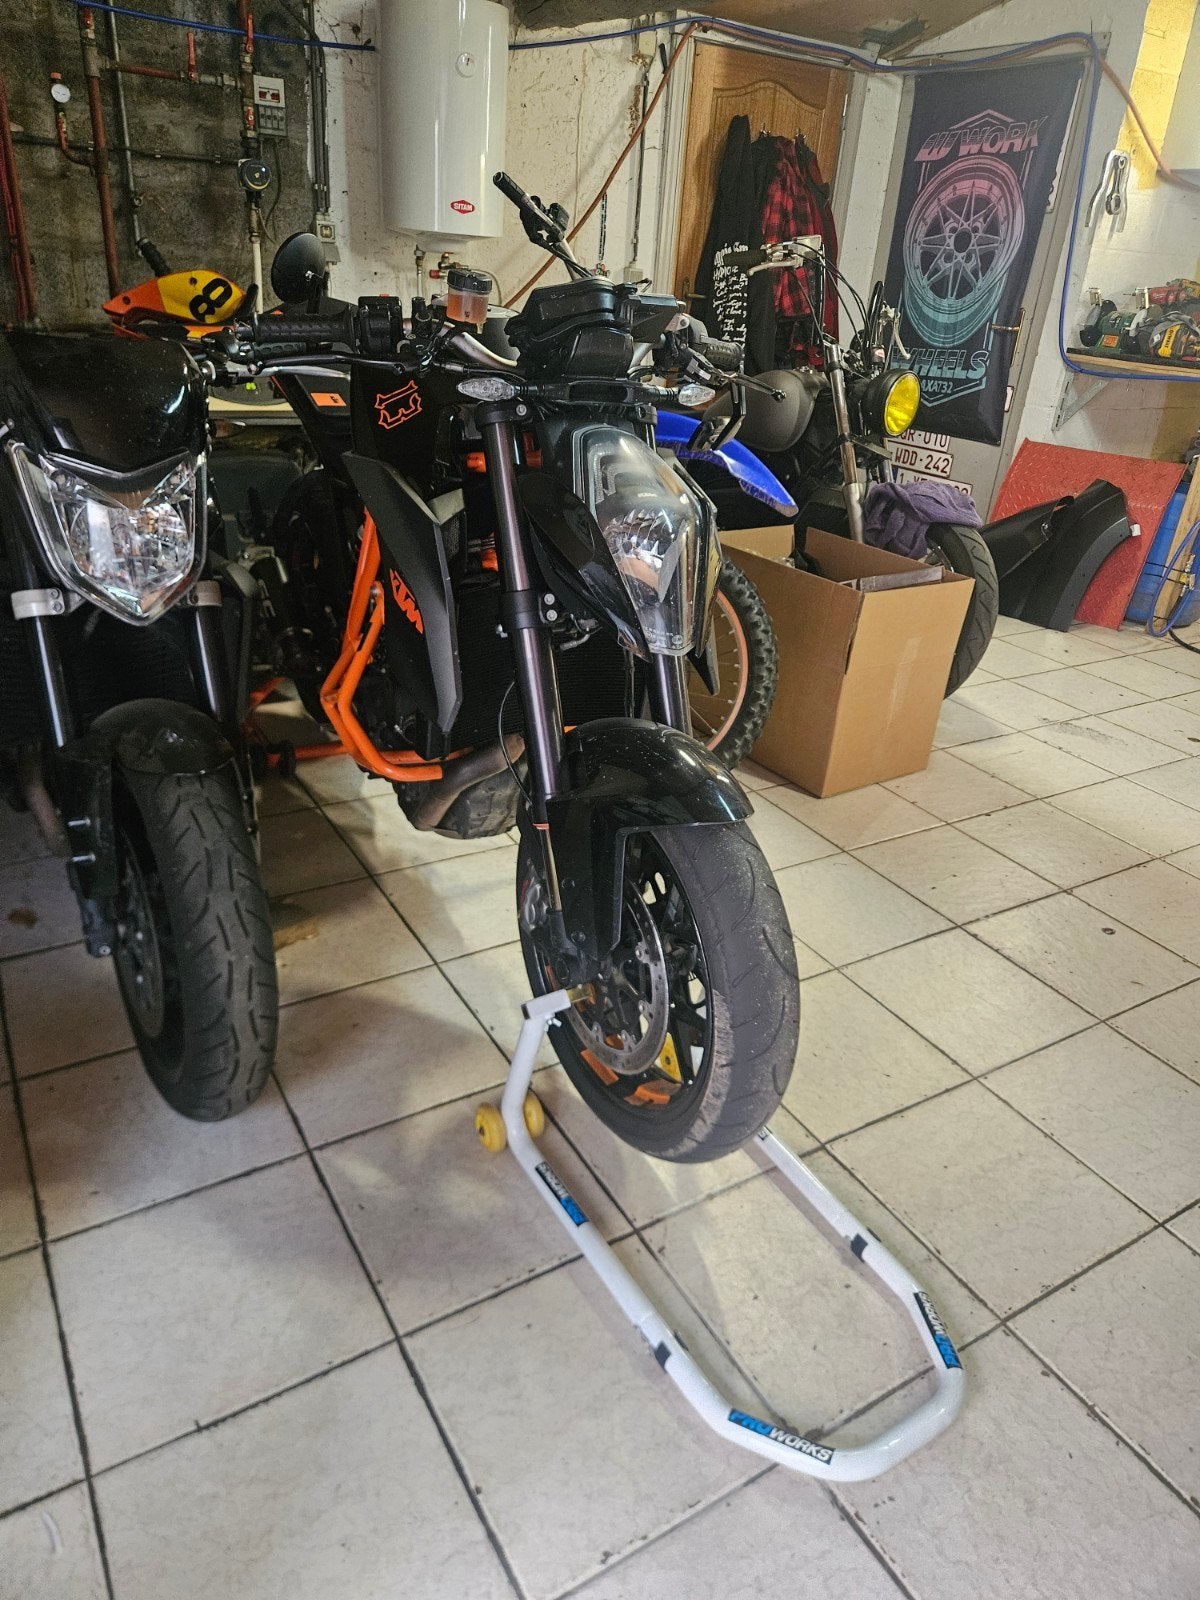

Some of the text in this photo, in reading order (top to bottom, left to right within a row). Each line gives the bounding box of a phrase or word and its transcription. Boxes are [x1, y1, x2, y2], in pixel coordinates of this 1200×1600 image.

[958, 116, 1048, 156] WORK
[890, 347, 989, 380] WHEELS
[389, 568, 424, 635] KTM
